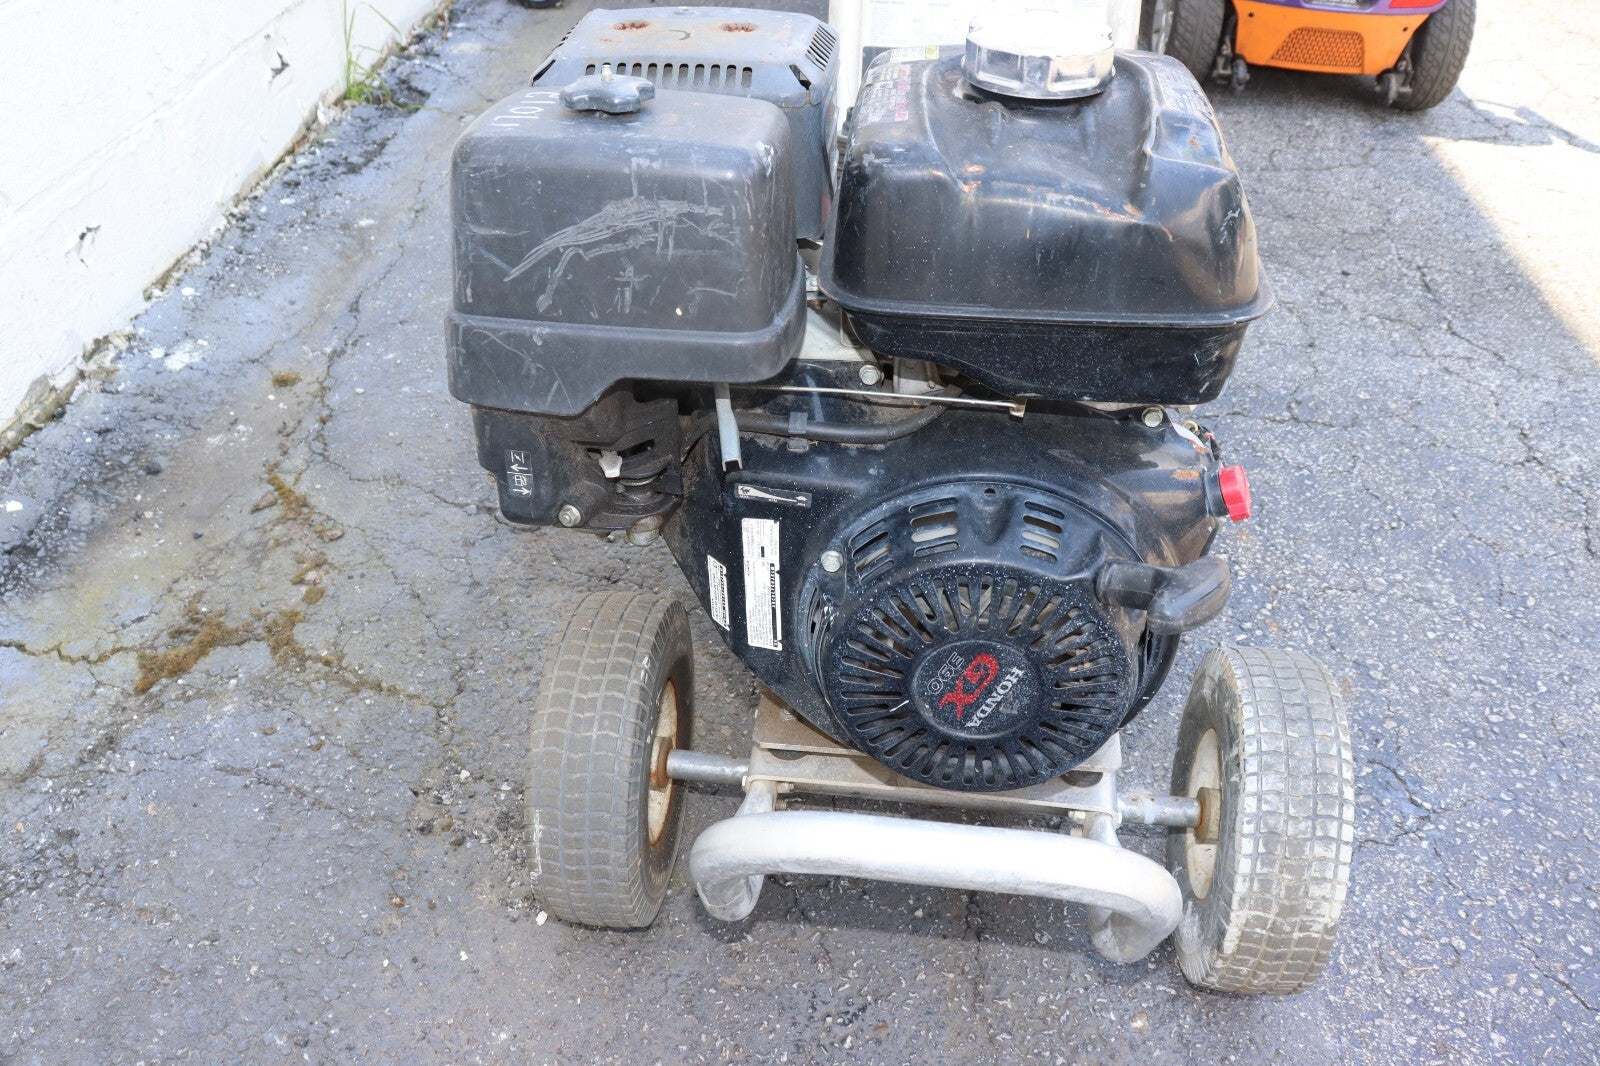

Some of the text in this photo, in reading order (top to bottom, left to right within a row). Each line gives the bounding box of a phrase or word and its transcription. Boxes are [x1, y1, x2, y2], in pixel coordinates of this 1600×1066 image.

[927, 651, 965, 695] 390
[937, 653, 999, 721] GX
[964, 666, 1025, 728] HONDA
